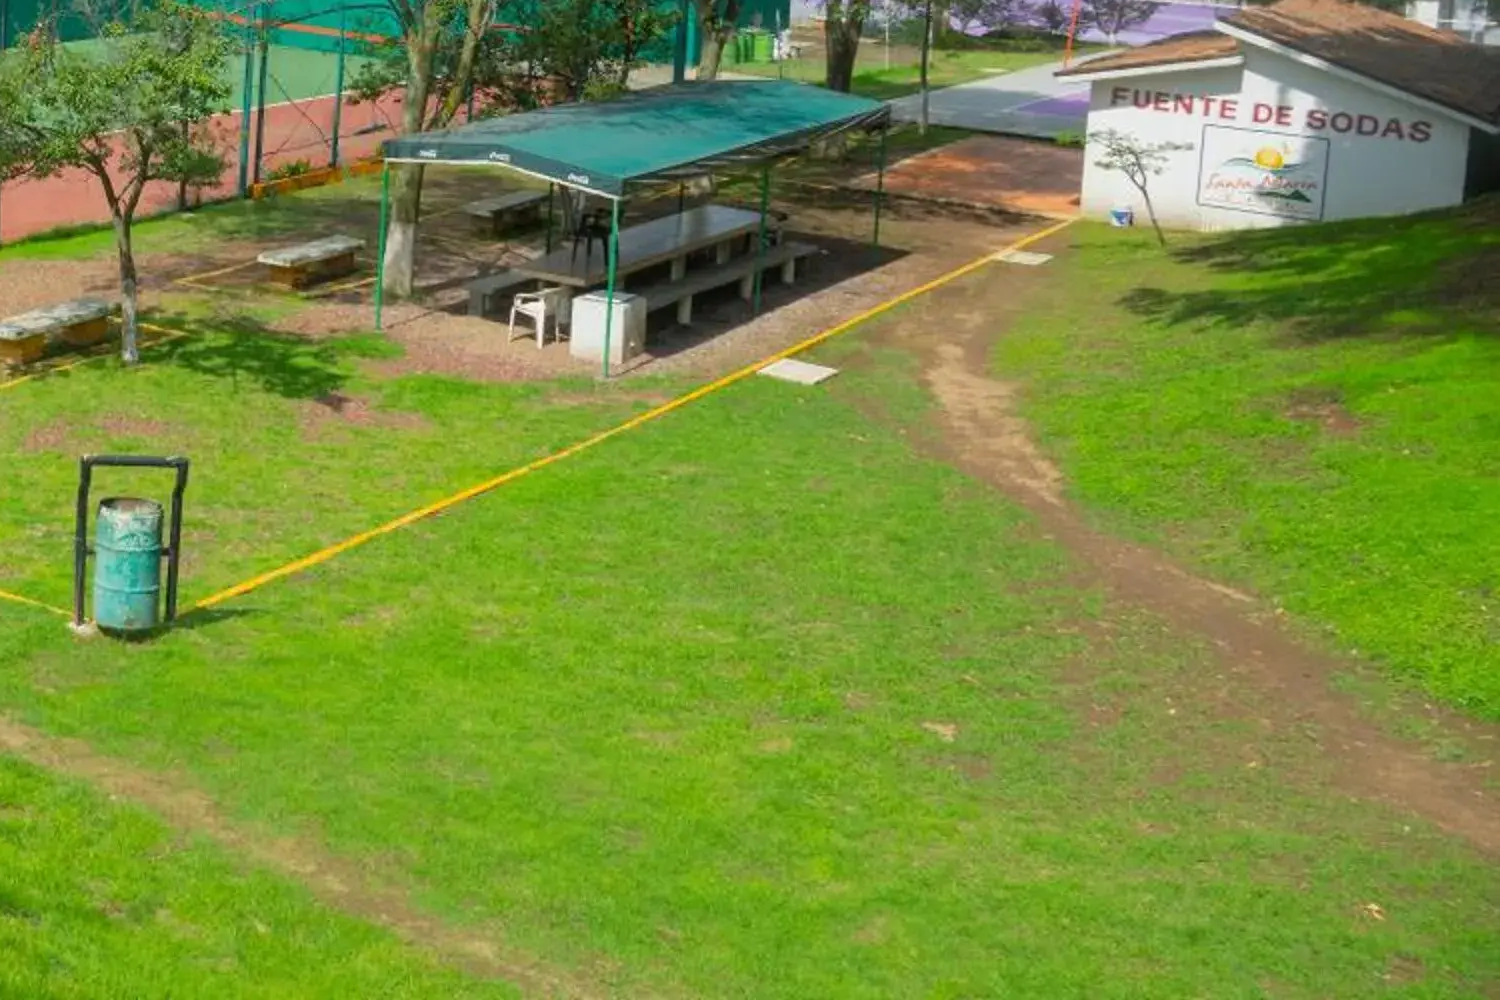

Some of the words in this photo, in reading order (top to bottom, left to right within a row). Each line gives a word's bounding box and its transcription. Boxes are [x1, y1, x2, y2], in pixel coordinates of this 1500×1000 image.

[1110, 86, 1238, 120] FUENTE
[1252, 103, 1294, 126] DE
[1306, 109, 1433, 143] SODAS
